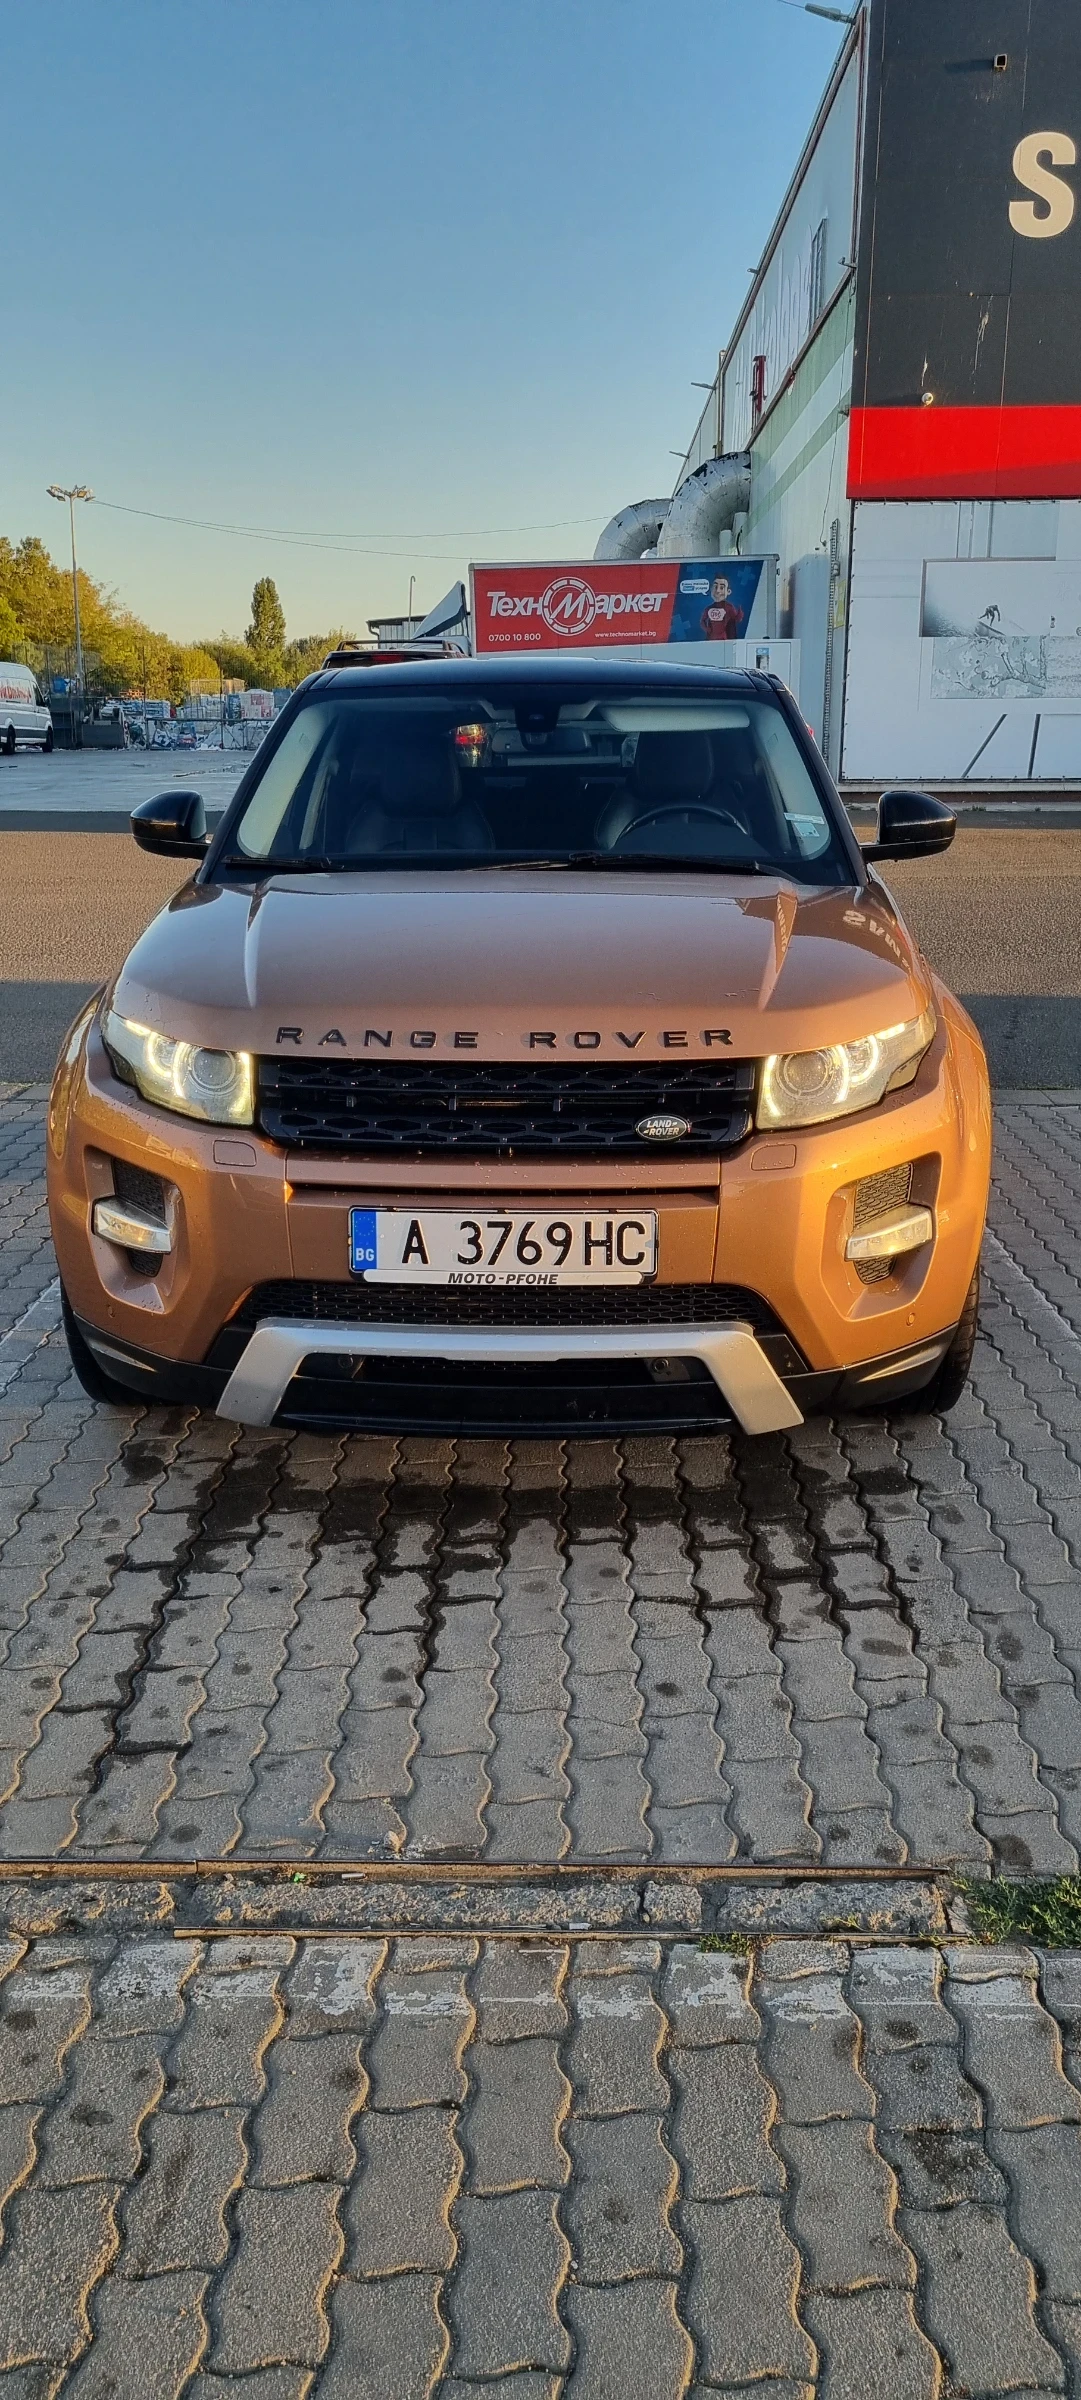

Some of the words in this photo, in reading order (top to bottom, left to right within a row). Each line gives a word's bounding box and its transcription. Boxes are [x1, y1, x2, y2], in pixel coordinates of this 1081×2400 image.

[1008, 131, 1076, 238] S
[488, 634, 511, 642] 0700
[512, 633, 522, 641] 10
[524, 632, 541, 641] 800
[275, 1026, 479, 1049] RANGE
[529, 1028, 734, 1050] ROVER
[647, 1120, 672, 1128] LAND
[649, 1127, 680, 1136] ROVER
[401, 1219, 430, 1265] A
[355, 1248, 375, 1262] BG
